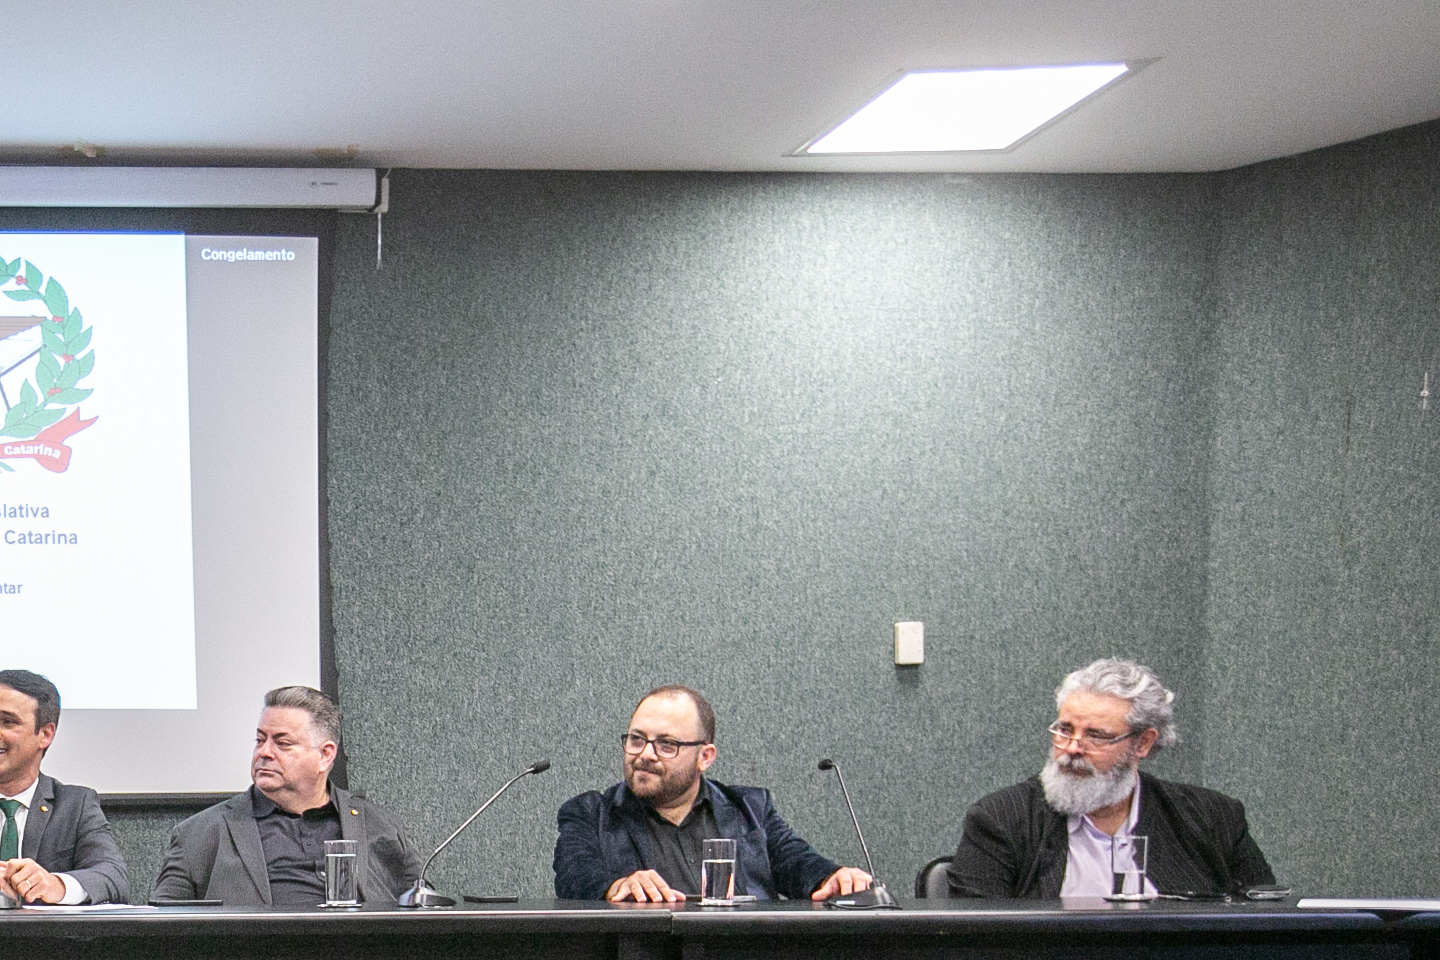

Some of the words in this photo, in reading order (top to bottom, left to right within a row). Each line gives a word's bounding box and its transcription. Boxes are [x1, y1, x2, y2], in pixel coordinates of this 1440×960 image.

[200, 248, 296, 262] Congelamento
[3, 443, 62, 459] Catarina
[3, 529, 78, 545] Catarina
